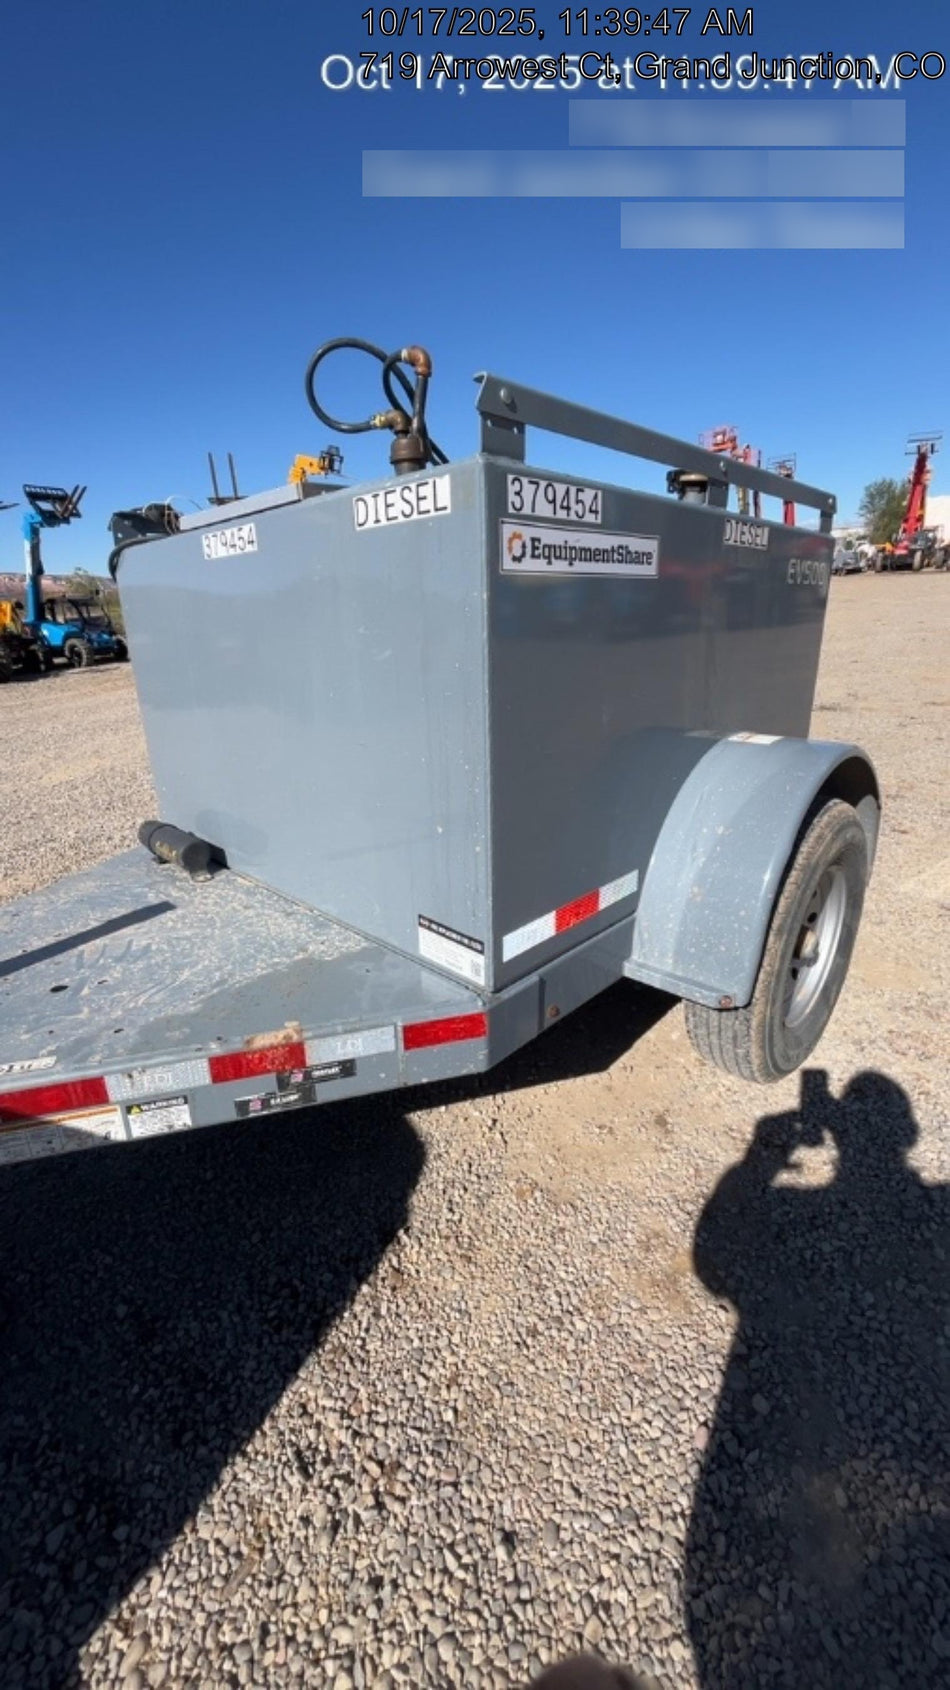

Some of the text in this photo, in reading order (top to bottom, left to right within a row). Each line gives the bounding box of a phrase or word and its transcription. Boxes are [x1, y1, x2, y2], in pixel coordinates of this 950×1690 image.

[355, 478, 448, 527] DIESEL
[510, 476, 599, 520] 379454
[204, 525, 254, 559] 379454
[724, 518, 768, 548] DIESEL
[529, 536, 655, 567] EquipmentShare
